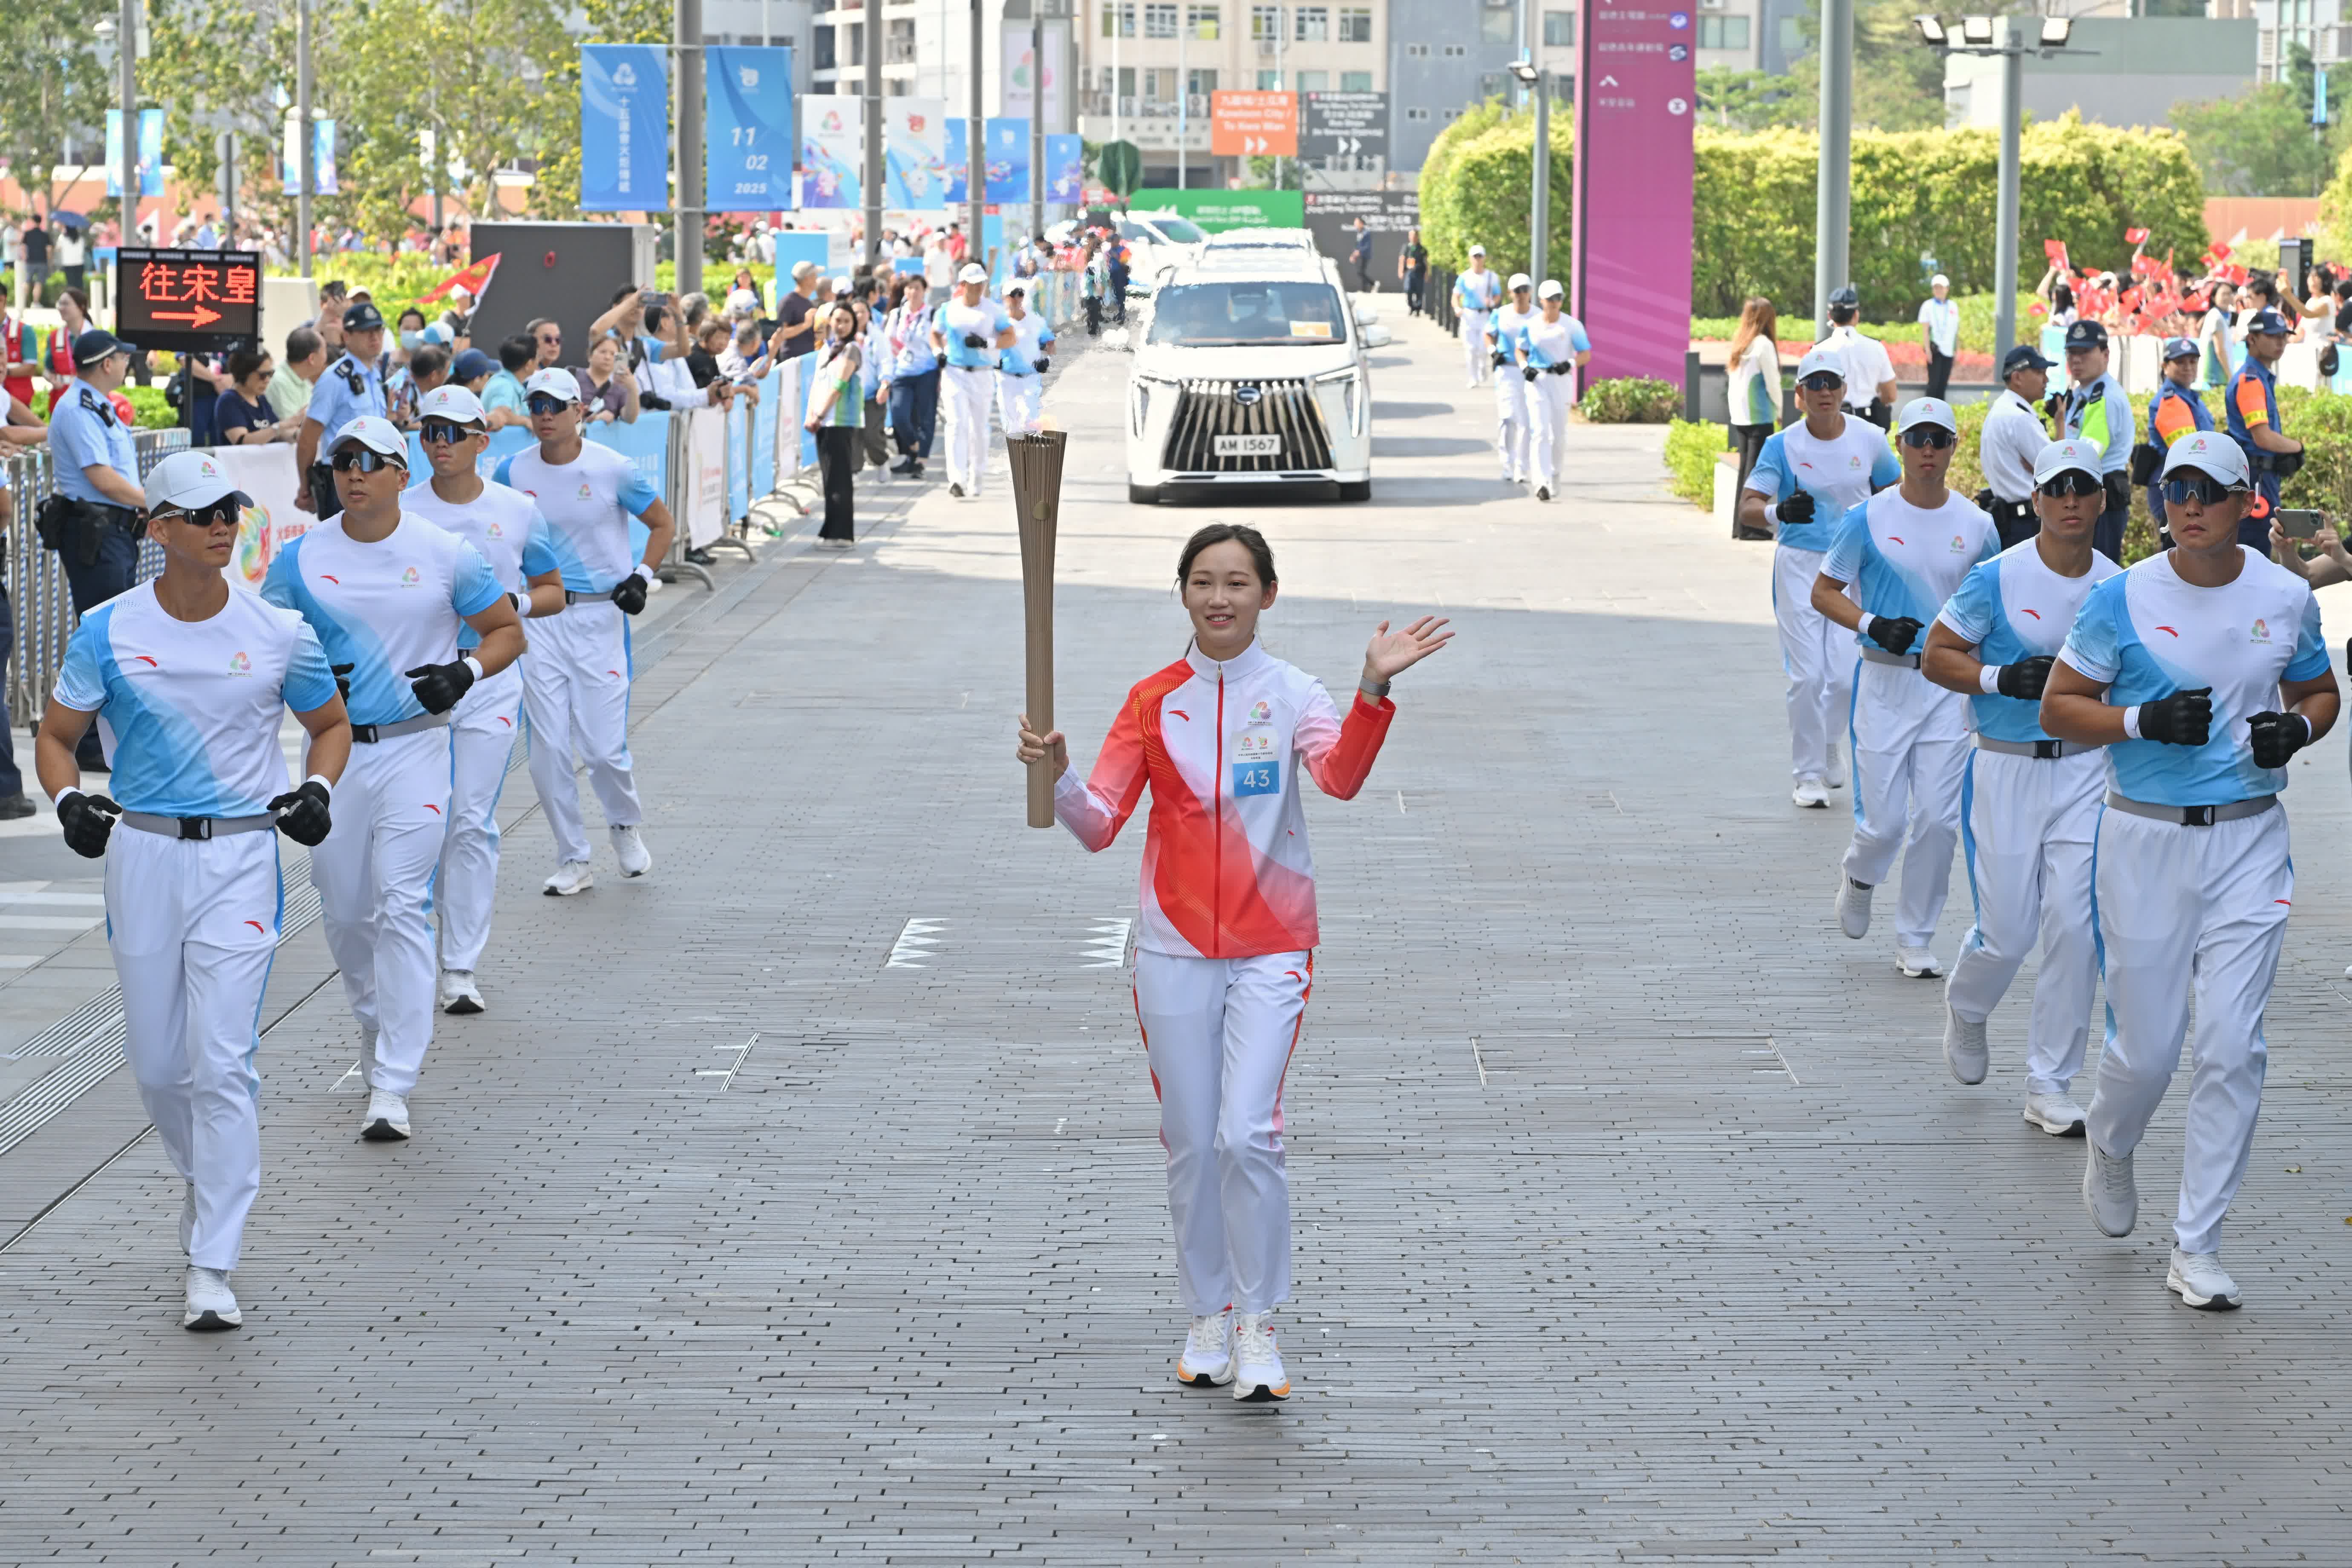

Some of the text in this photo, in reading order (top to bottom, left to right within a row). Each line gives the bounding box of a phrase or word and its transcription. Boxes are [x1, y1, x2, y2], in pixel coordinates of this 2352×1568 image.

[731, 126, 756, 146] 11
[745, 155, 767, 170] 02
[734, 182, 767, 194] 2025
[140, 262, 255, 303] 往宋皇
[1220, 439, 1275, 450] AM 1567
[1243, 770, 1270, 787] 43
